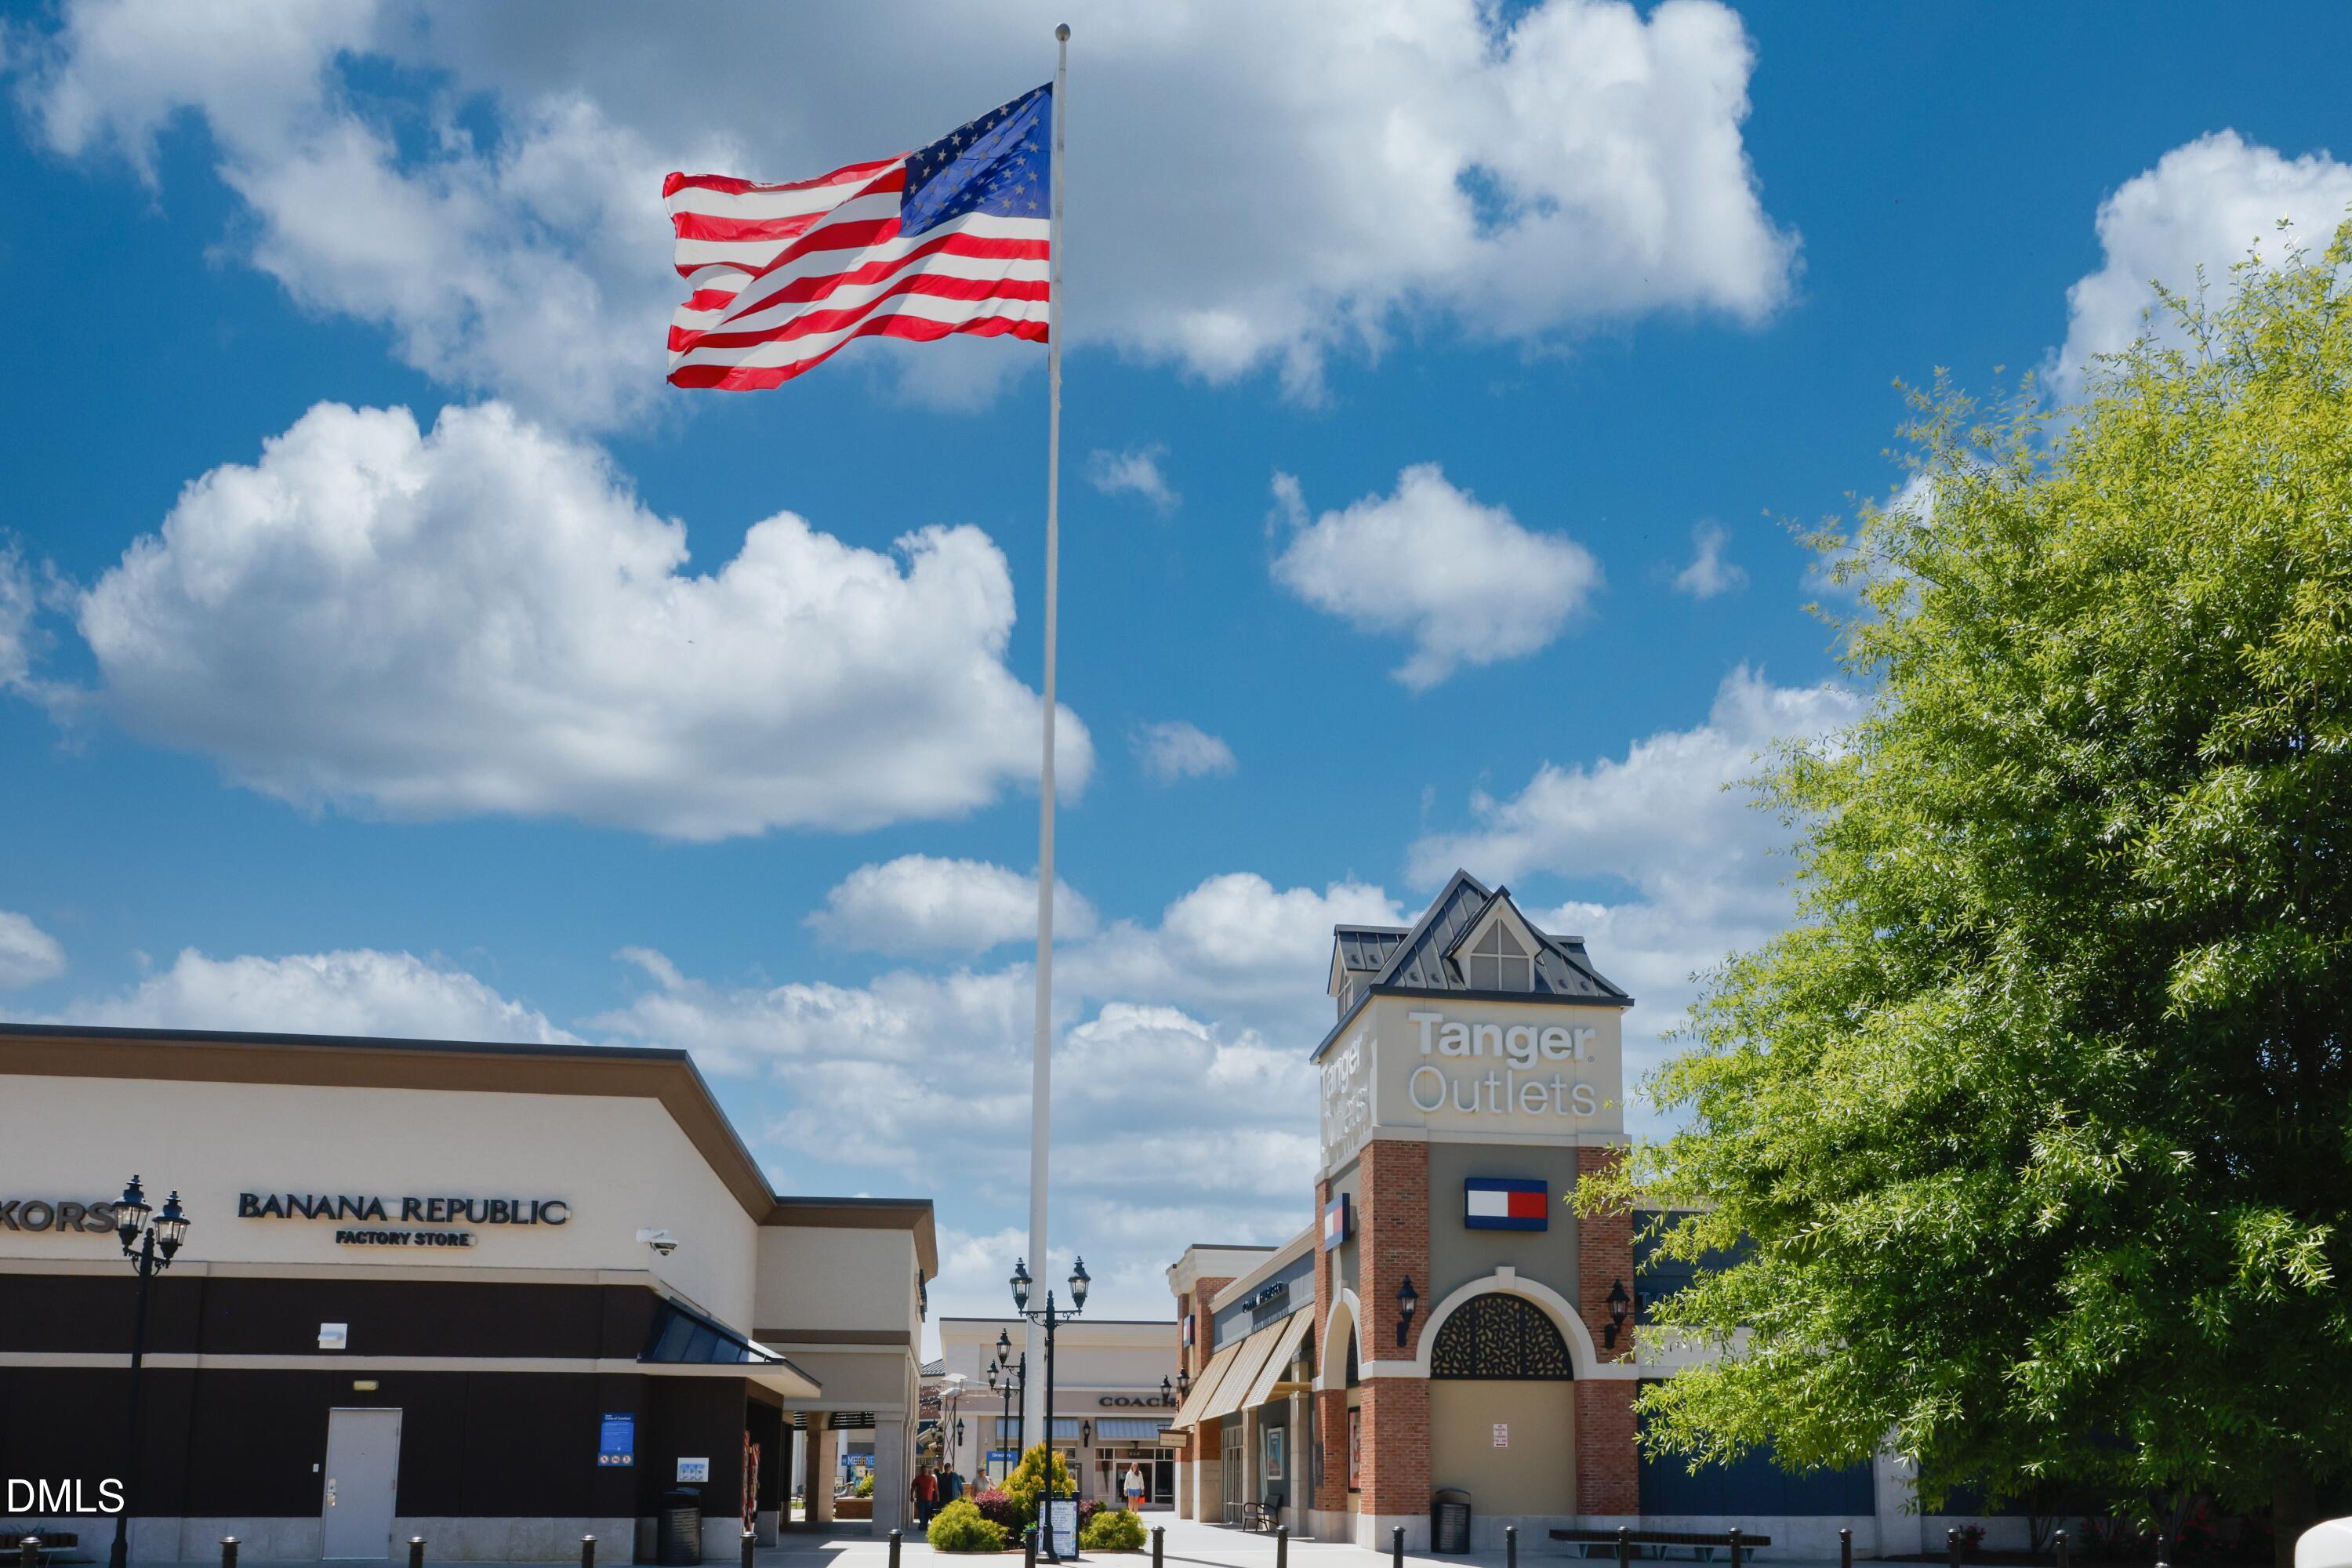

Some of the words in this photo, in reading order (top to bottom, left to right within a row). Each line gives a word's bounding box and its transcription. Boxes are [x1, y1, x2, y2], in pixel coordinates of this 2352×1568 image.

[1408, 1011, 1596, 1069] Tanger
[1320, 1032, 1363, 1102] Tanger
[1408, 1065, 1596, 1116] Outlets
[0, 1200, 117, 1232] KORS
[238, 1192, 389, 1221] BANANA
[401, 1196, 567, 1225] REPUBLIC
[336, 1231, 411, 1245] FACTORY
[414, 1232, 470, 1247] STORE
